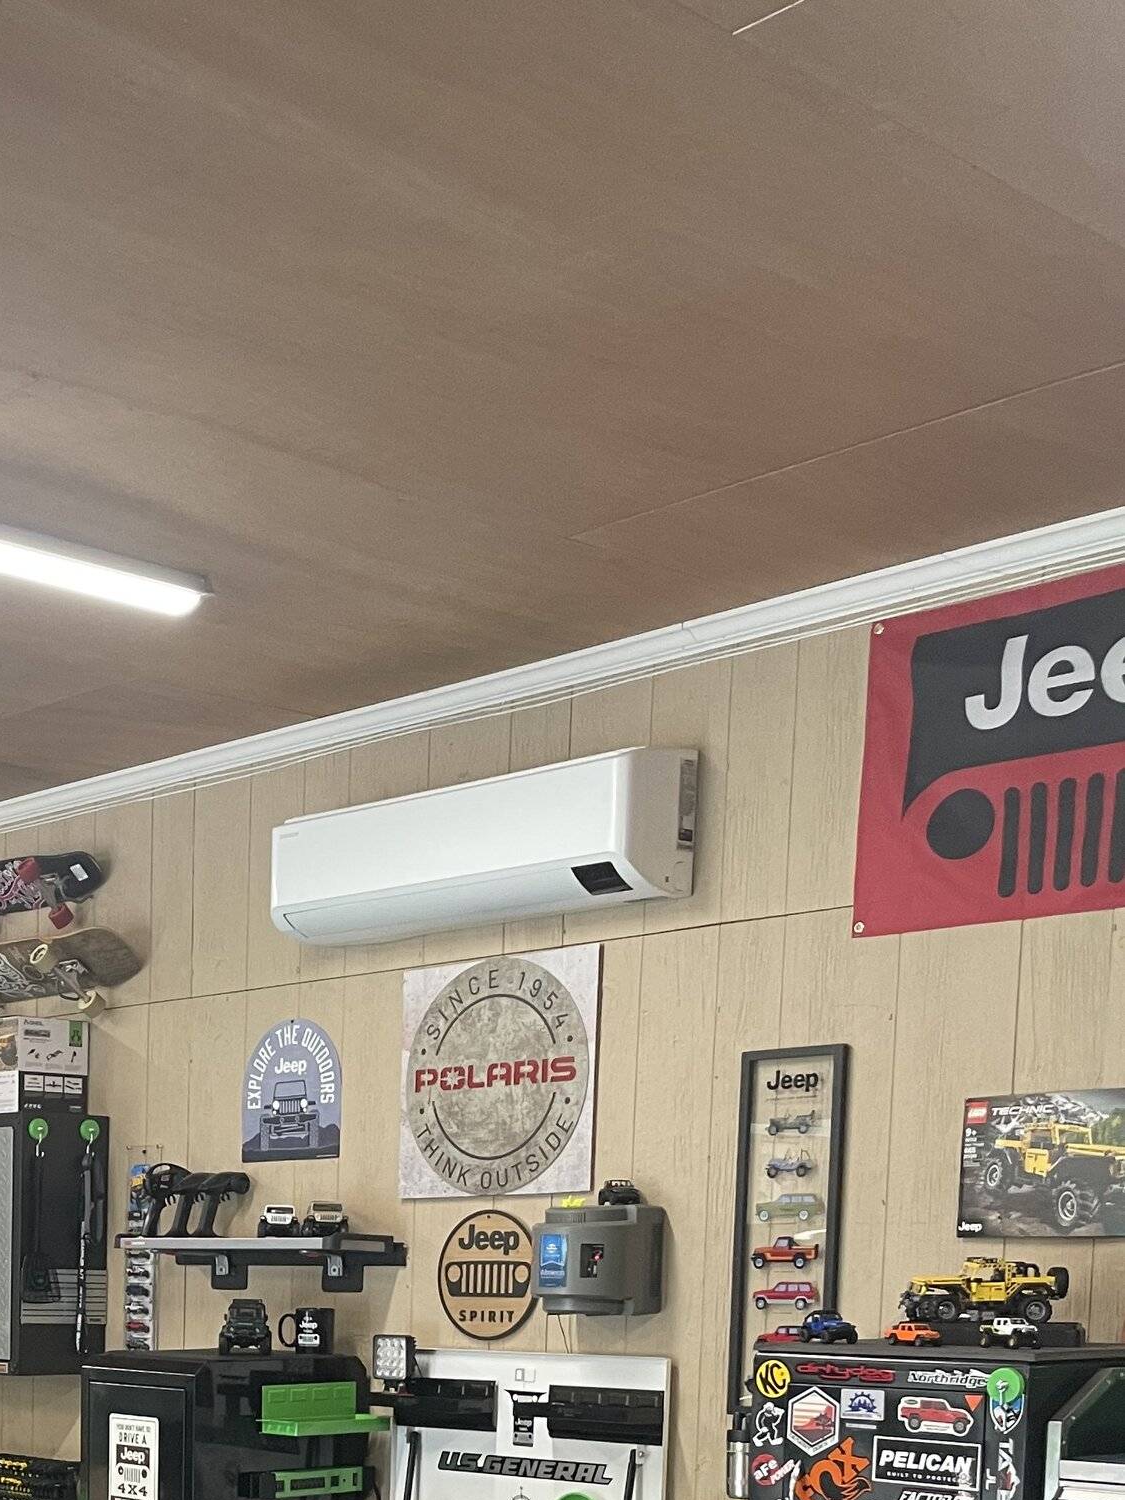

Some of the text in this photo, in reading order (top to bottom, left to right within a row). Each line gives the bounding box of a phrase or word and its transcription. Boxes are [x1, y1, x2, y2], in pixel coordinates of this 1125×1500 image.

[426, 967, 569, 1041] SINCE 1954
[246, 1024, 336, 1110] EXPLORE THE OUTDOORS
[273, 1056, 309, 1077] Jeep
[413, 1055, 578, 1094] POLARIS
[766, 1069, 820, 1093] Jeep
[991, 1104, 1056, 1116] TECHNIC
[416, 1116, 575, 1190] THINK OUTSIDE
[957, 1220, 983, 1233] Jeep
[458, 1223, 520, 1256] Jeep
[458, 1308, 516, 1324] SPIRIT
[758, 1361, 787, 1396] KC
[118, 1431, 147, 1445] DRIVE A
[120, 1446, 146, 1466] Jeep
[878, 1449, 973, 1475] PELICAN
[926, 1474, 963, 1484] PROTEC
